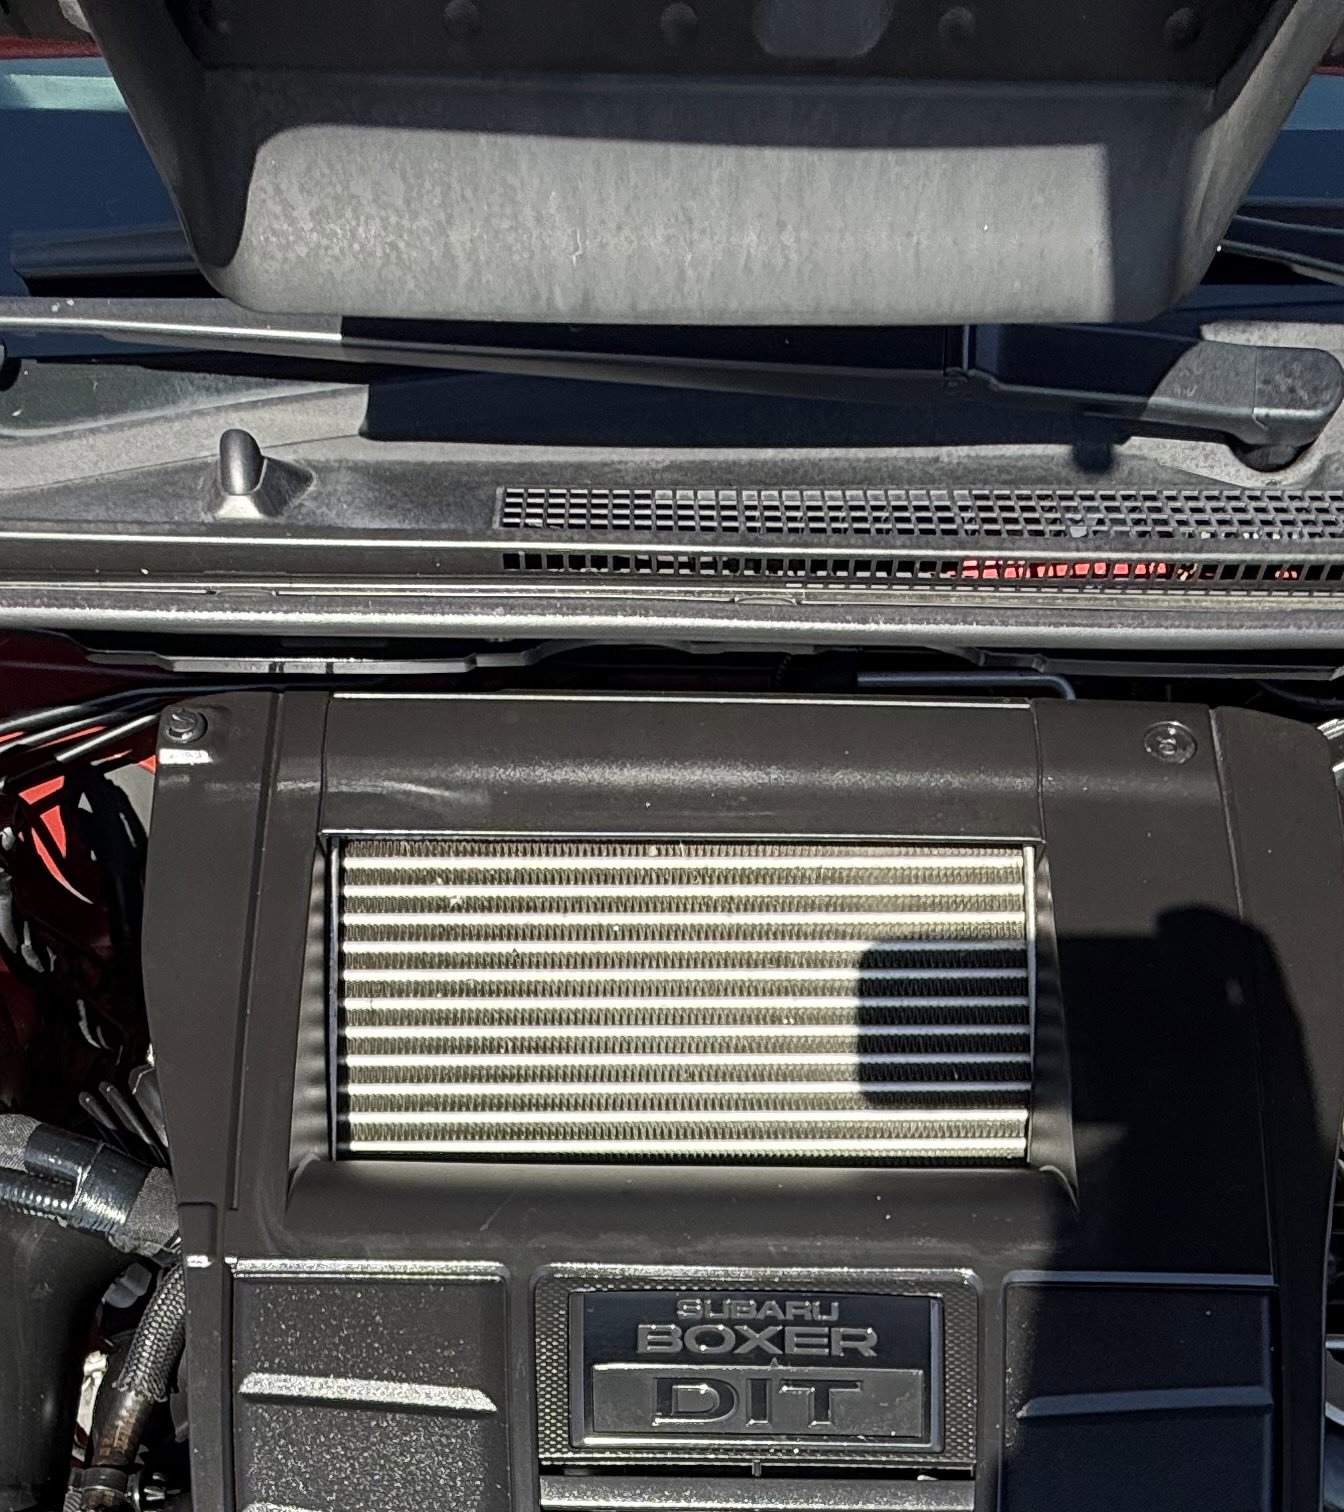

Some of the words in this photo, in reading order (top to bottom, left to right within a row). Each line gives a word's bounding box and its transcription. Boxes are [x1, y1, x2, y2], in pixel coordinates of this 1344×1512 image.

[676, 1298, 840, 1322] SUBARU
[636, 1324, 880, 1357] BOXER
[653, 1376, 864, 1428] DIT
